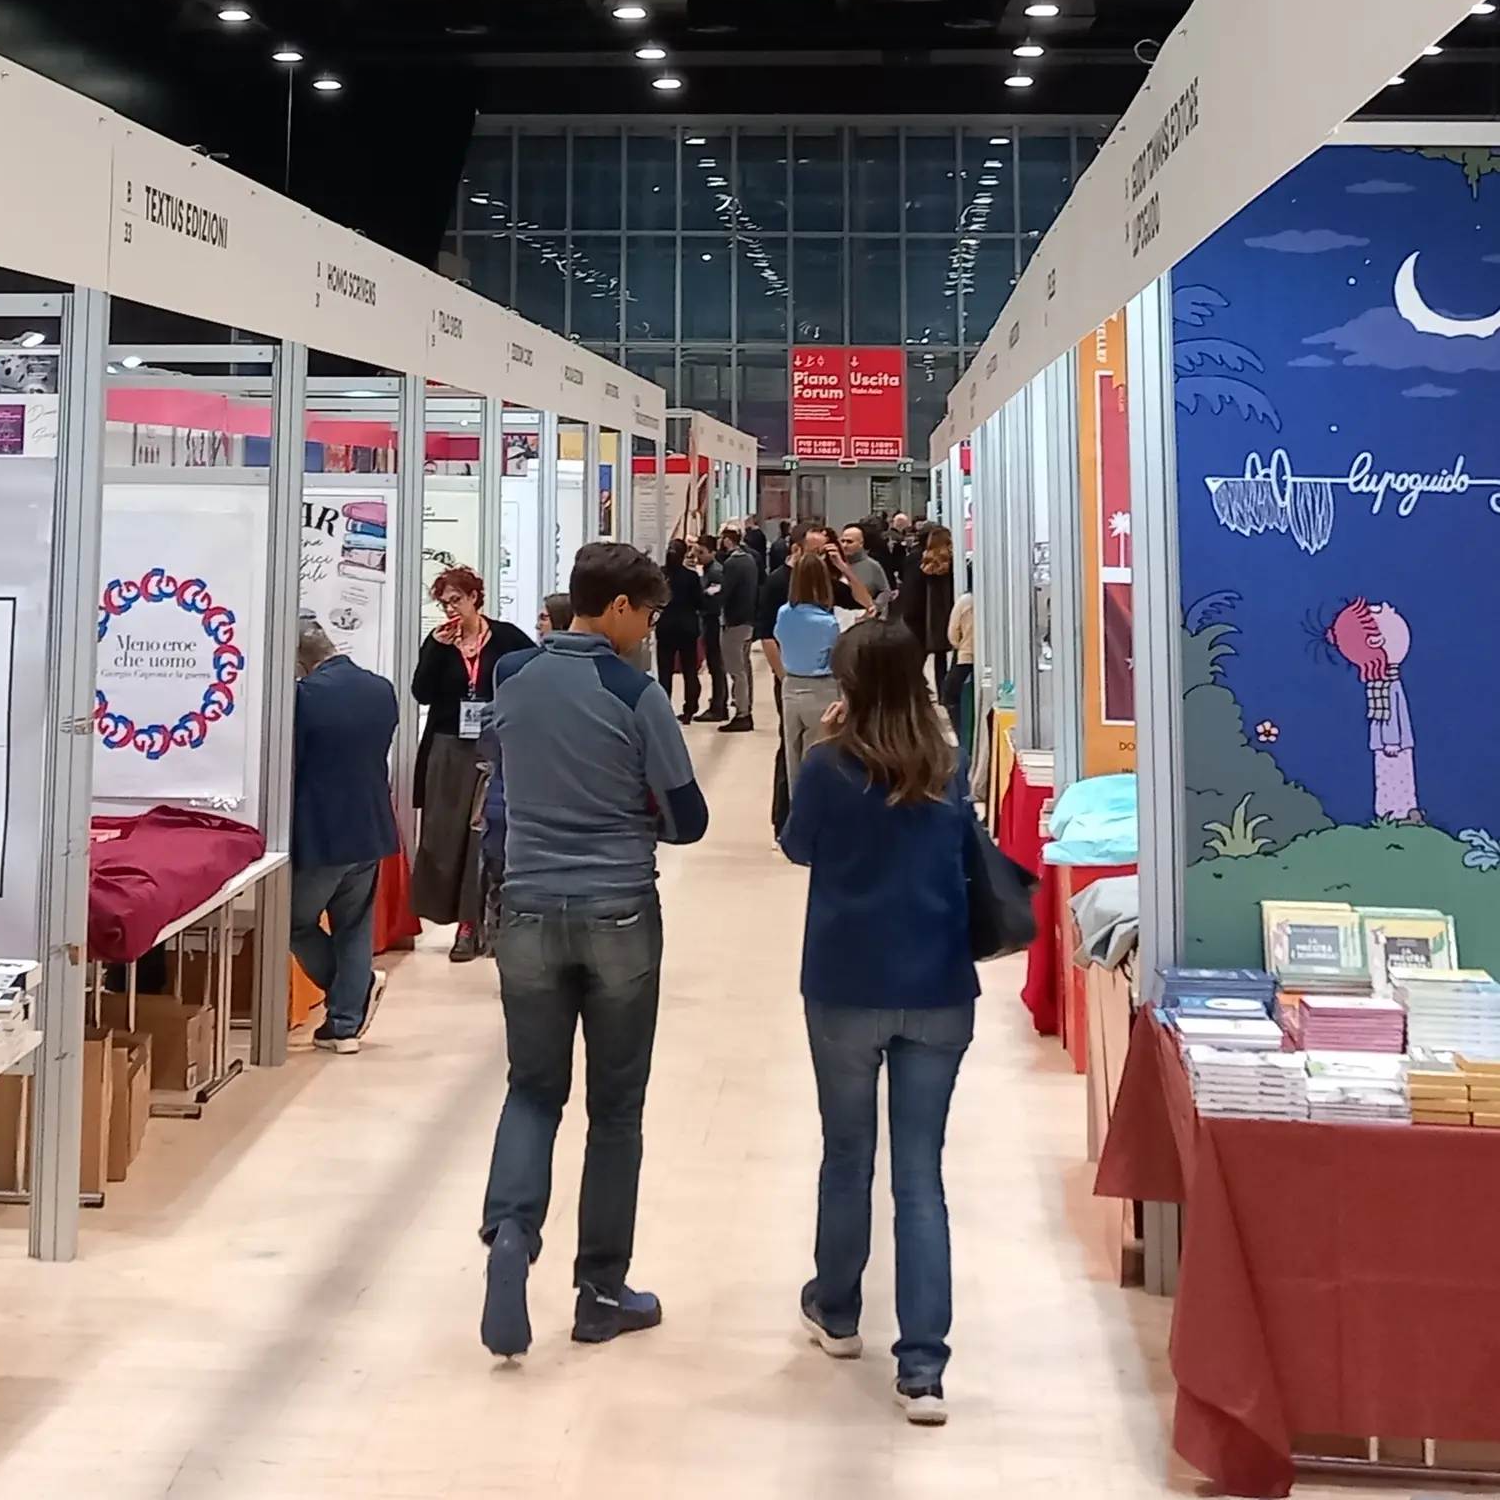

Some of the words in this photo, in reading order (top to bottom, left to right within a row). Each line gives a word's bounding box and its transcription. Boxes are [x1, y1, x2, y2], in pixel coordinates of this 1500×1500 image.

[145, 185, 184, 233] TEXTUS
[185, 202, 229, 249] EDIZIONI
[793, 371, 838, 385] Piano
[850, 372, 900, 386] Uscita
[793, 385, 844, 399] Forum
[1349, 452, 1469, 516] lupoguido
[117, 634, 161, 651] Meno
[162, 639, 197, 651] eroe
[114, 651, 144, 668] che
[149, 655, 196, 668] uomo
